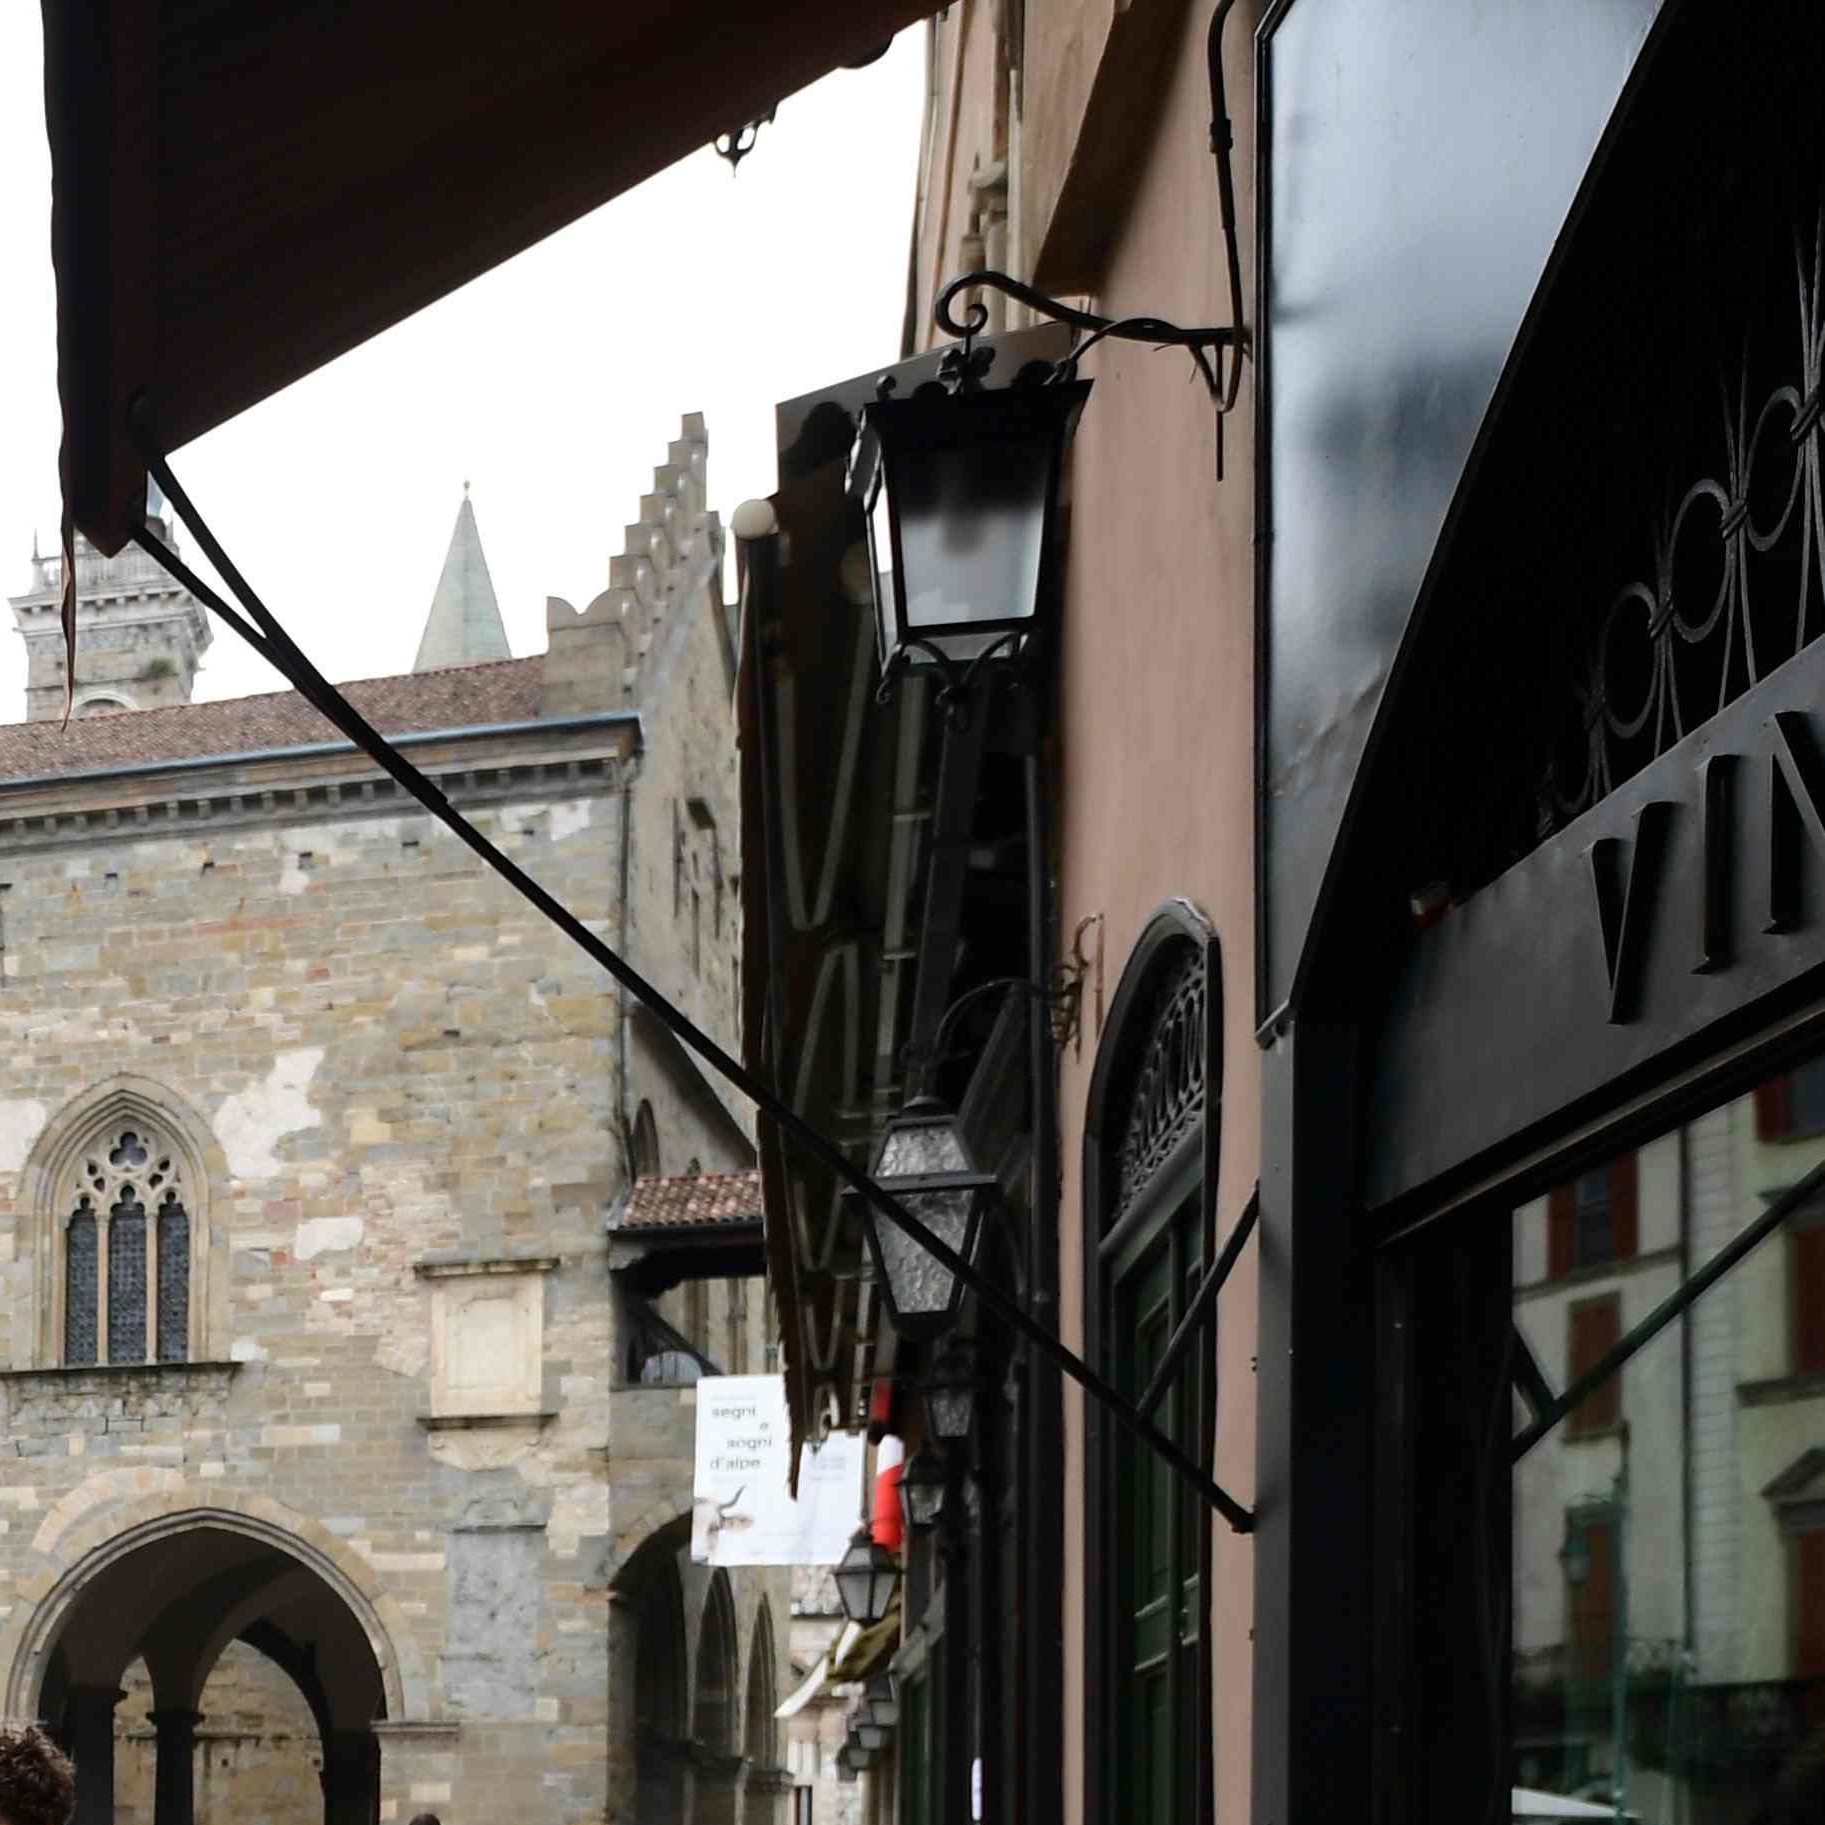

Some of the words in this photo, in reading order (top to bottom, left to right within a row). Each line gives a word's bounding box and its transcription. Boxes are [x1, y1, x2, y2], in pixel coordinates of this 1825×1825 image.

[712, 1407, 757, 1420] segni
[726, 1437, 773, 1452] sogni
[710, 1456, 761, 1472] d'alpe
